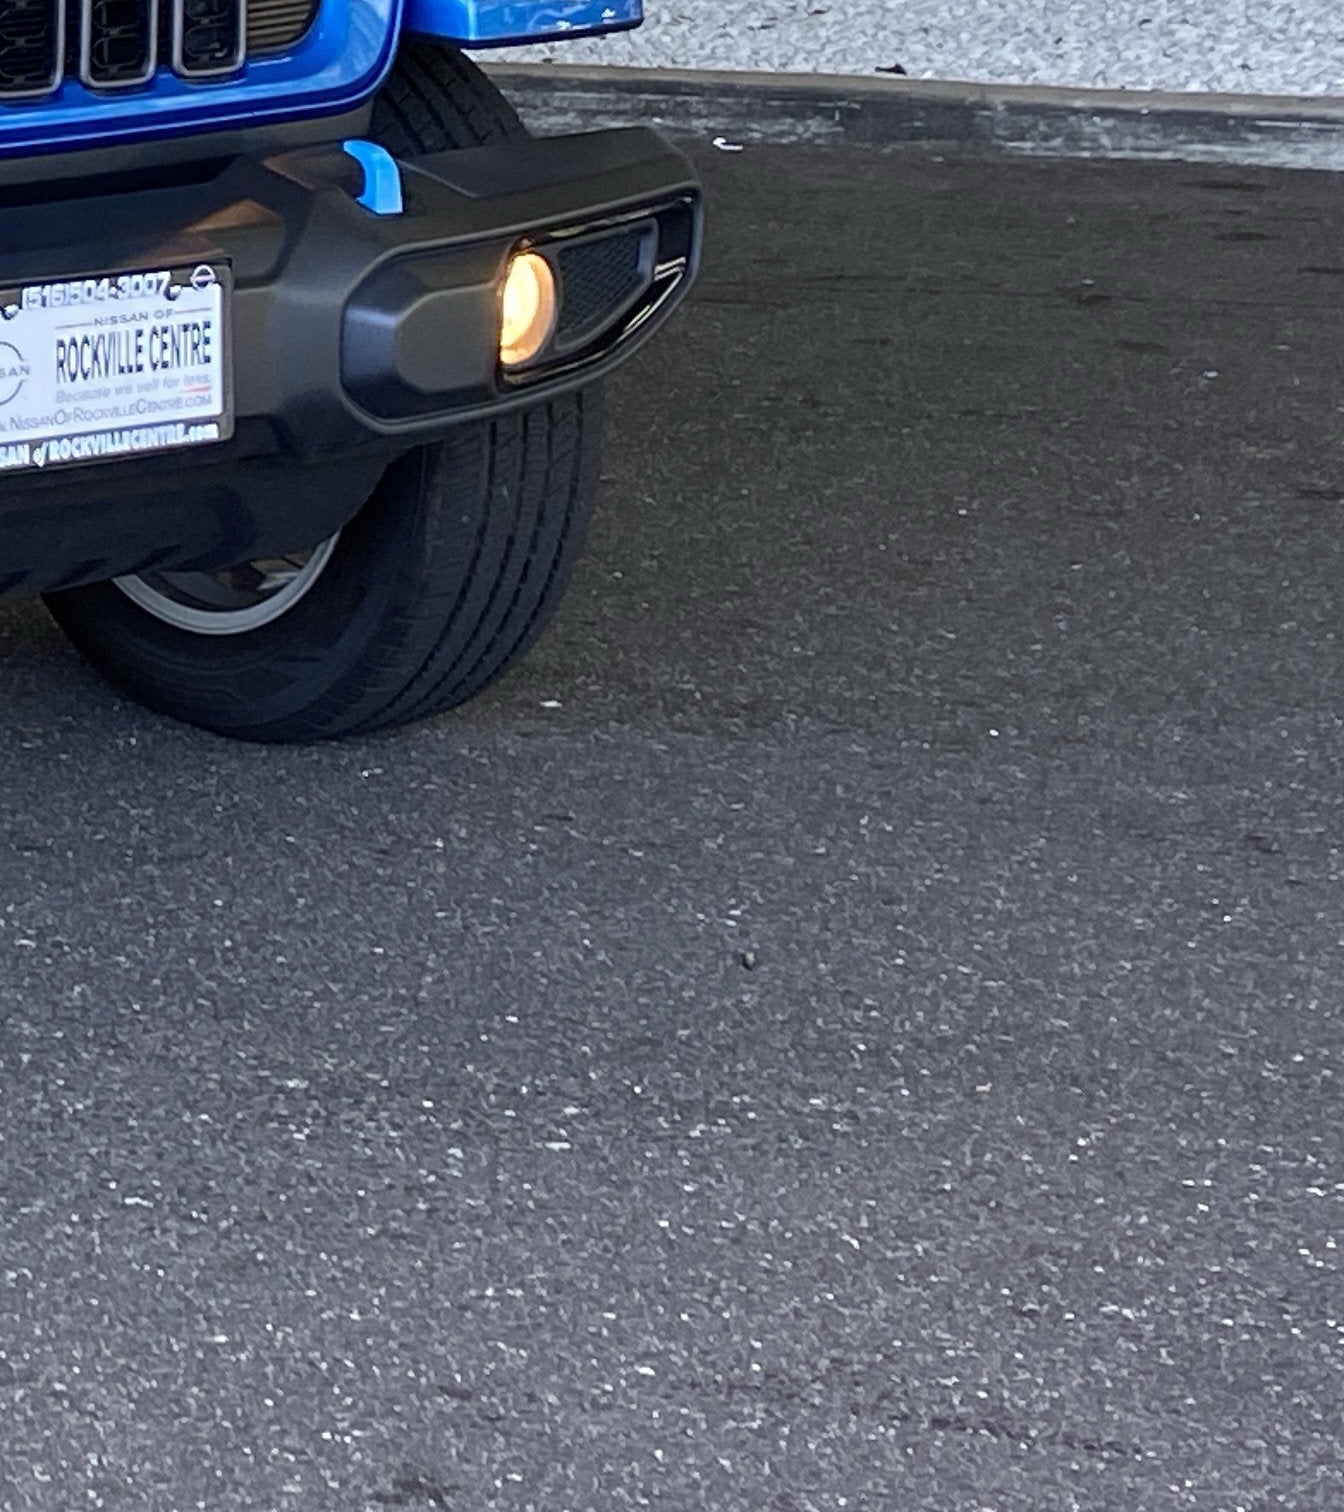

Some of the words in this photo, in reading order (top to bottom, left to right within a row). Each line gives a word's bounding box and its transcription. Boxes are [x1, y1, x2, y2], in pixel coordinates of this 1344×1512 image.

[94, 311, 150, 326] NISSAN
[153, 308, 174, 320] OF
[56, 329, 145, 384] ROCKVILLE
[149, 320, 212, 372] CENTRE
